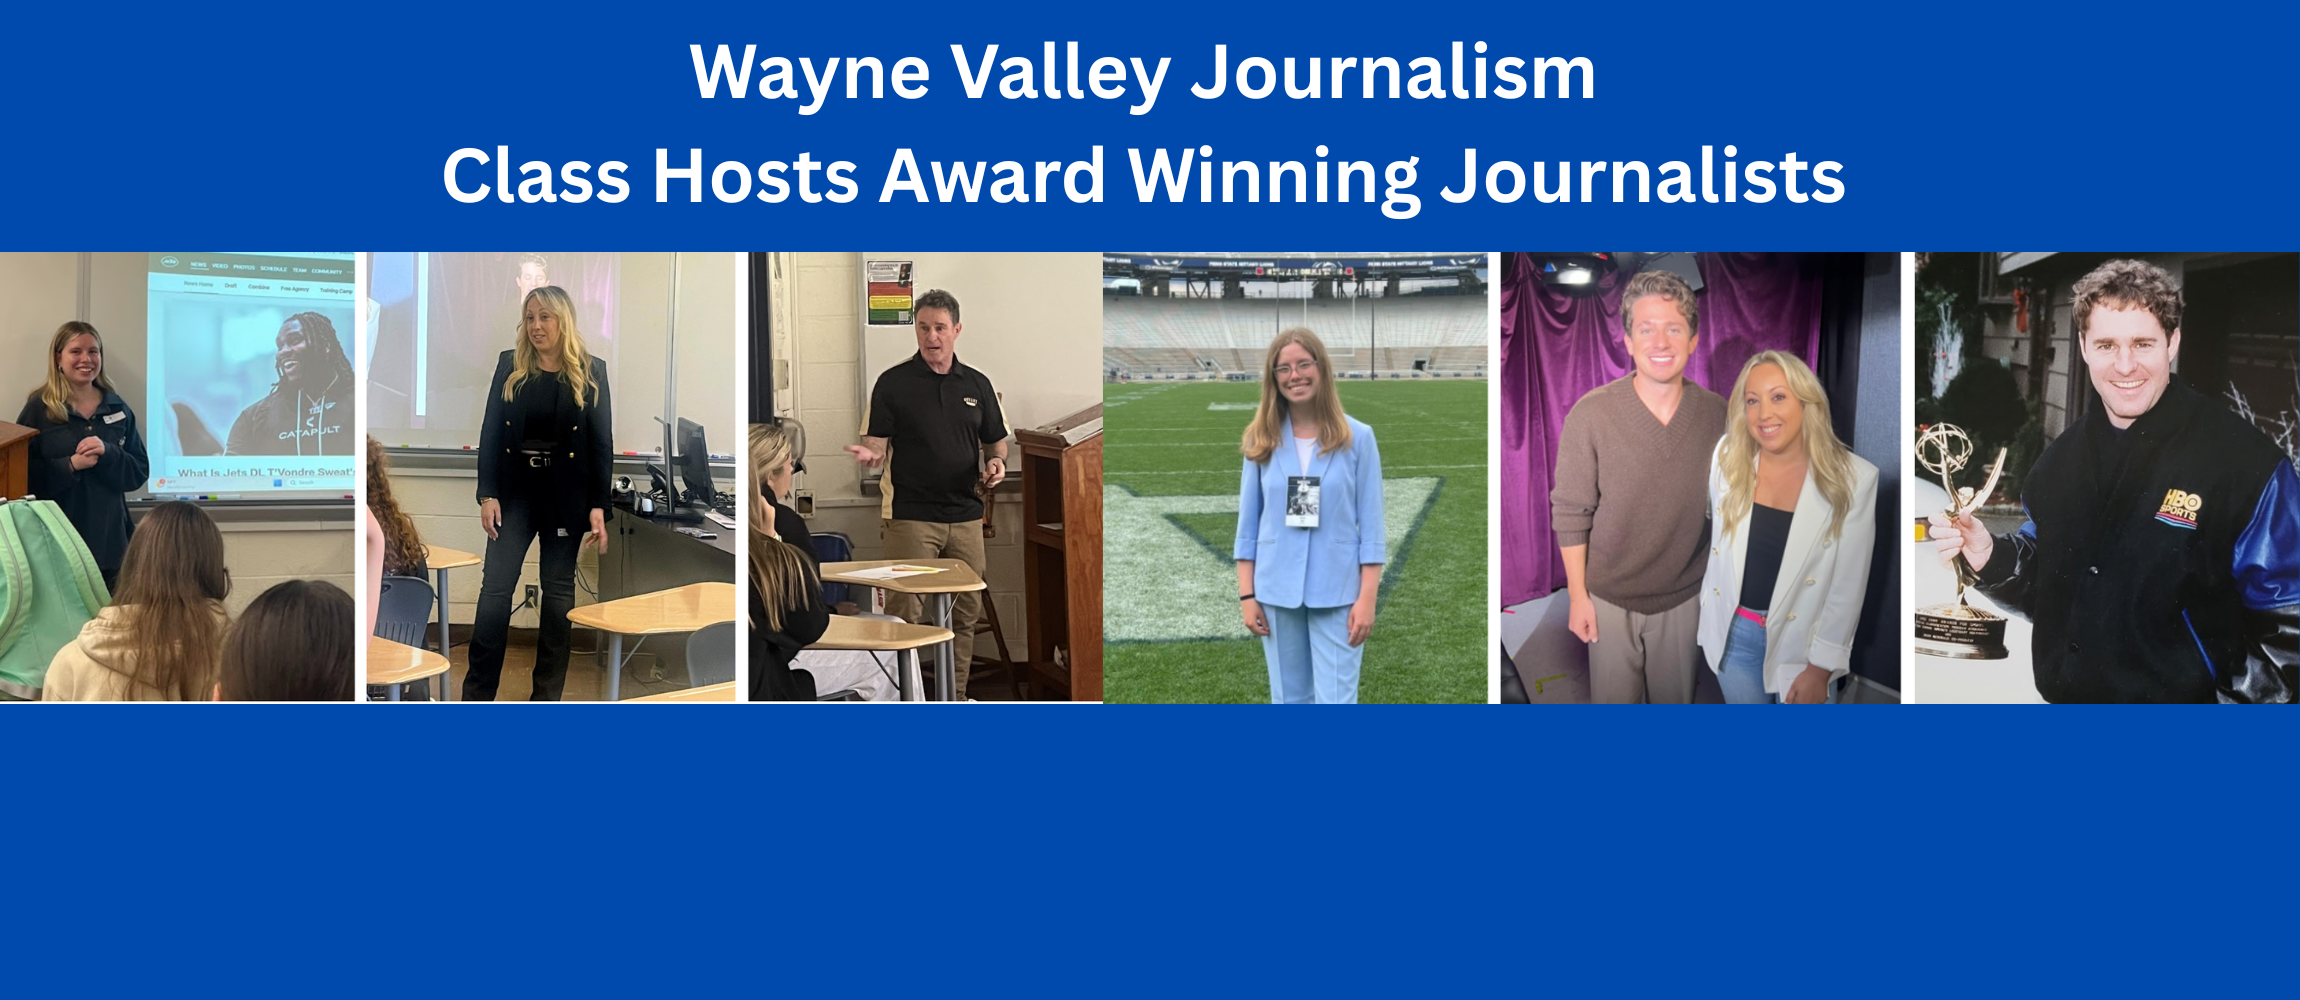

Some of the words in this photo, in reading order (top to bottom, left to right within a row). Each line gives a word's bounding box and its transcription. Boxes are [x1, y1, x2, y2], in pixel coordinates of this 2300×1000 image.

[278, 425, 340, 440] CATAPULT
[178, 468, 207, 477] What
[210, 468, 220, 477] Is
[223, 468, 248, 477] Jets
[250, 468, 265, 477] DL
[267, 468, 315, 477] T'Vondre
[2163, 489, 2202, 511] HBO
[2160, 504, 2197, 521] SPORTS
